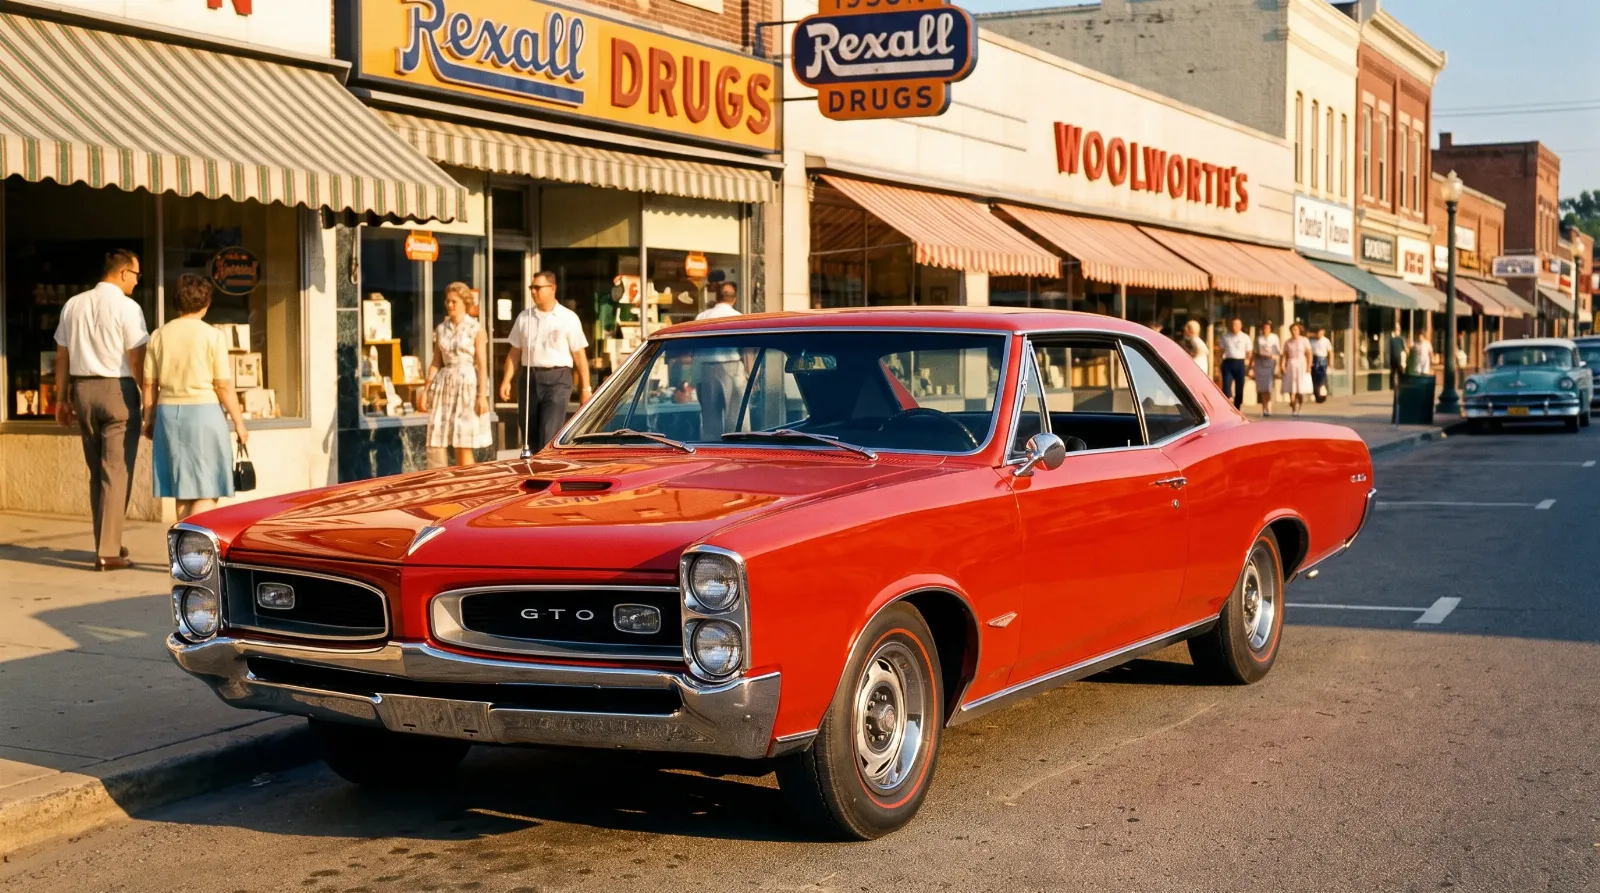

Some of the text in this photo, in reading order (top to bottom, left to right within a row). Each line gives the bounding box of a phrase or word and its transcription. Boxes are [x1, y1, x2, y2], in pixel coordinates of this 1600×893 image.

[395, 0, 771, 134] Rexall DRUGS
[805, 13, 955, 78] Rexall
[828, 86, 932, 113] DRUGS
[1053, 121, 1249, 213] WOOLWORTH'S
[520, 608, 595, 621] GTO
